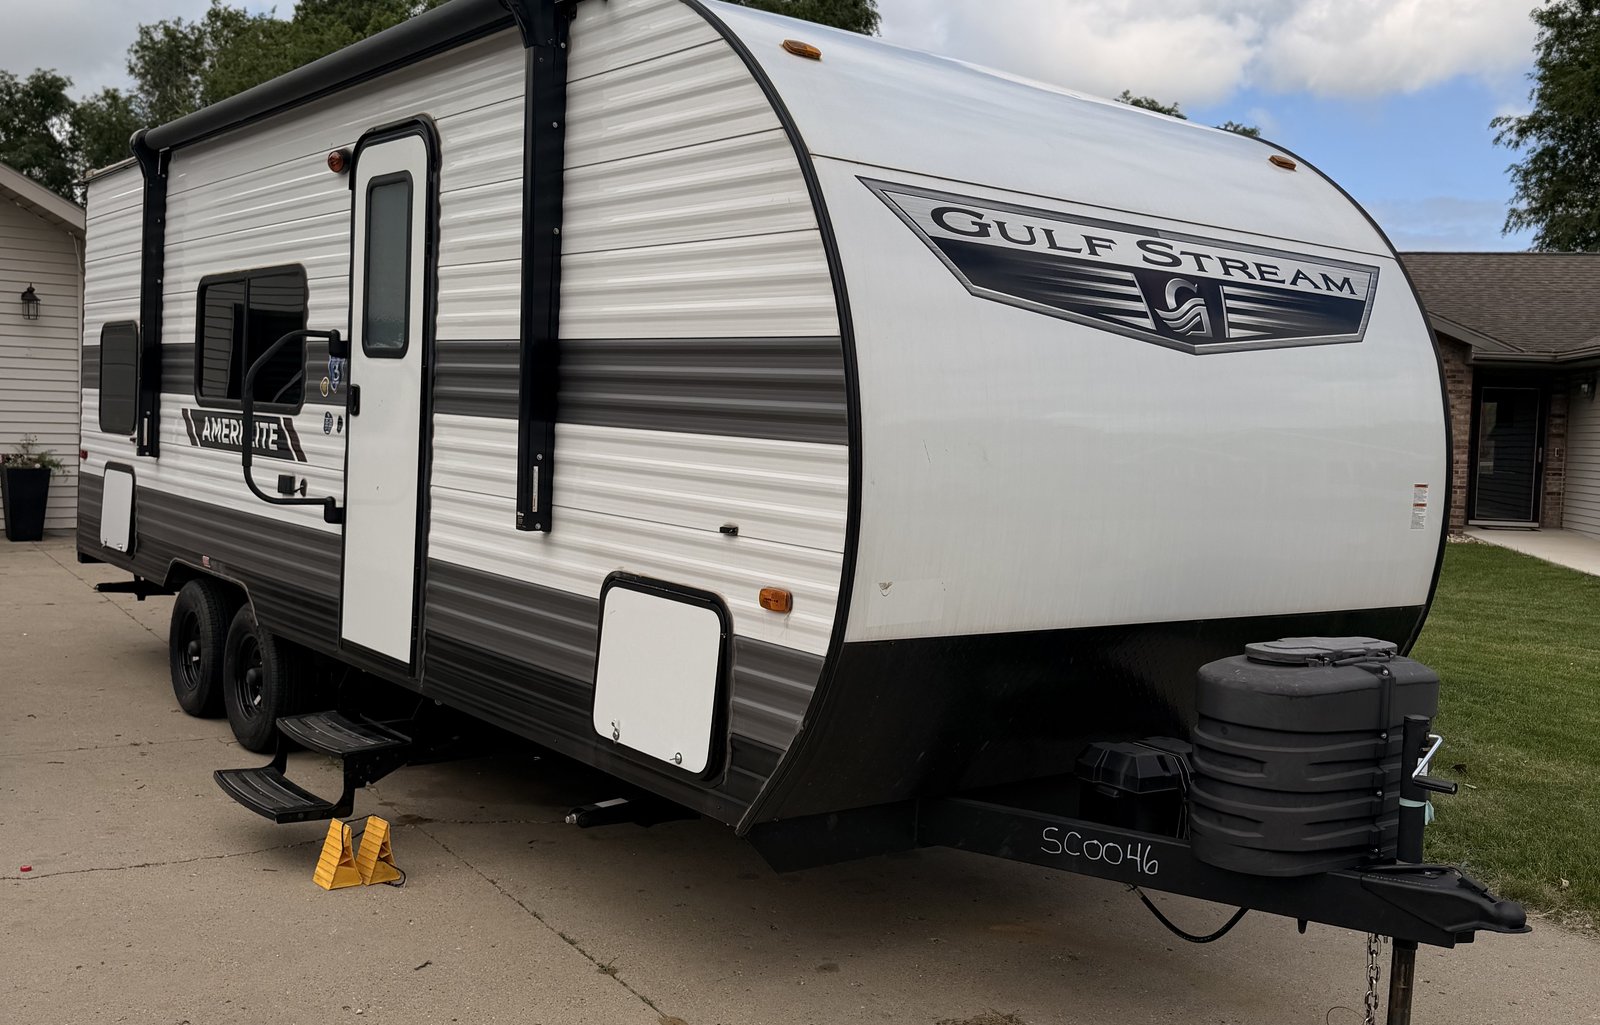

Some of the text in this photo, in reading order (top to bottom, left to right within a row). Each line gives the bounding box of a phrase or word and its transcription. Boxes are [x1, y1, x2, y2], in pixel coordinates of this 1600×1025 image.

[930, 205, 1358, 297] GULF STREAM
[202, 416, 278, 451] AMERIITE
